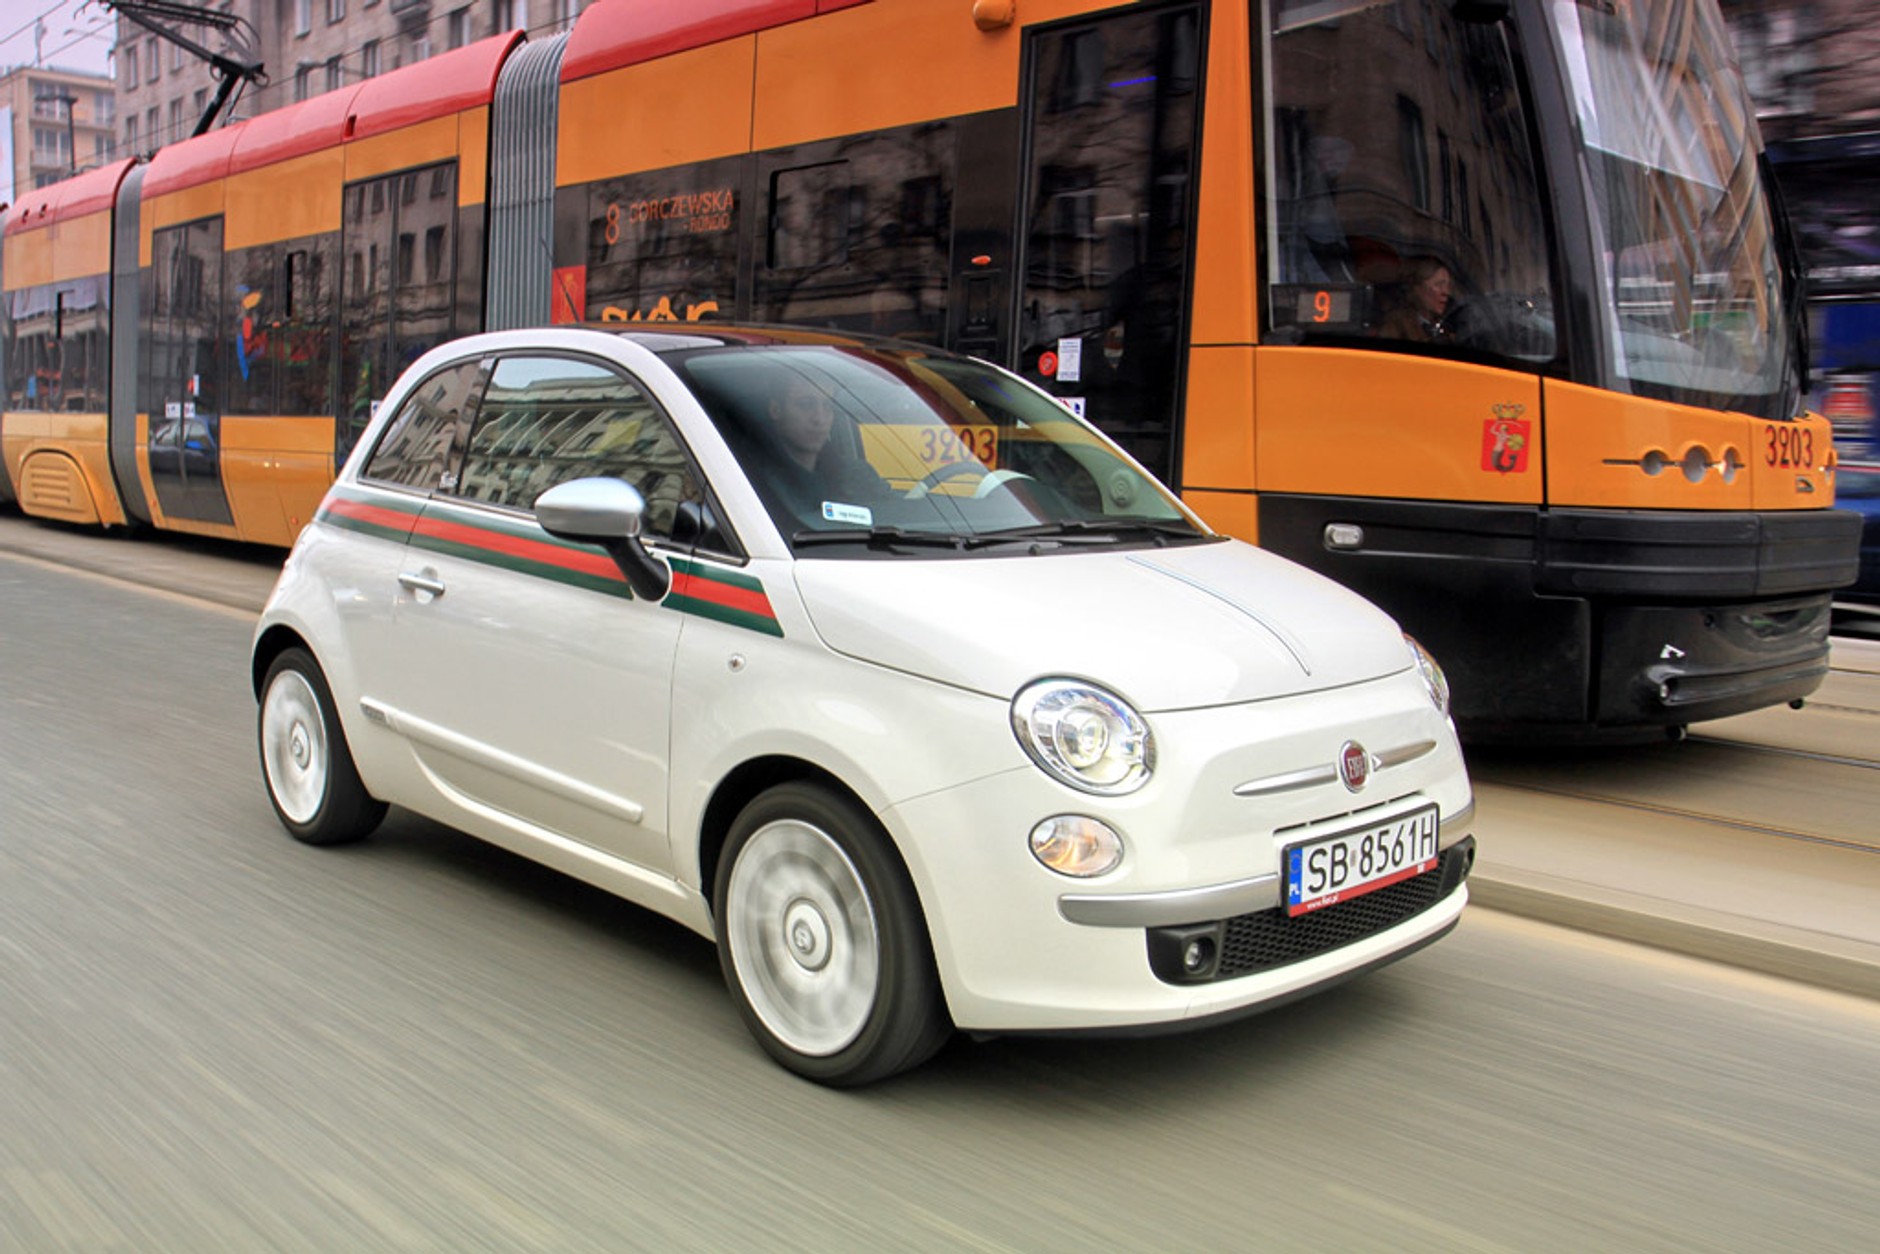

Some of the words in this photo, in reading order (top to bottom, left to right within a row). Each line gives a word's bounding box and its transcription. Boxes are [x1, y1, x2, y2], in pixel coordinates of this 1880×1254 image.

[606, 203, 620, 244] 8
[1313, 290, 1331, 322] 9
[920, 428, 995, 463] 3203
[1765, 424, 1813, 469] 3203
[1308, 842, 1348, 893] SB
[1359, 813, 1434, 877] 8561H
